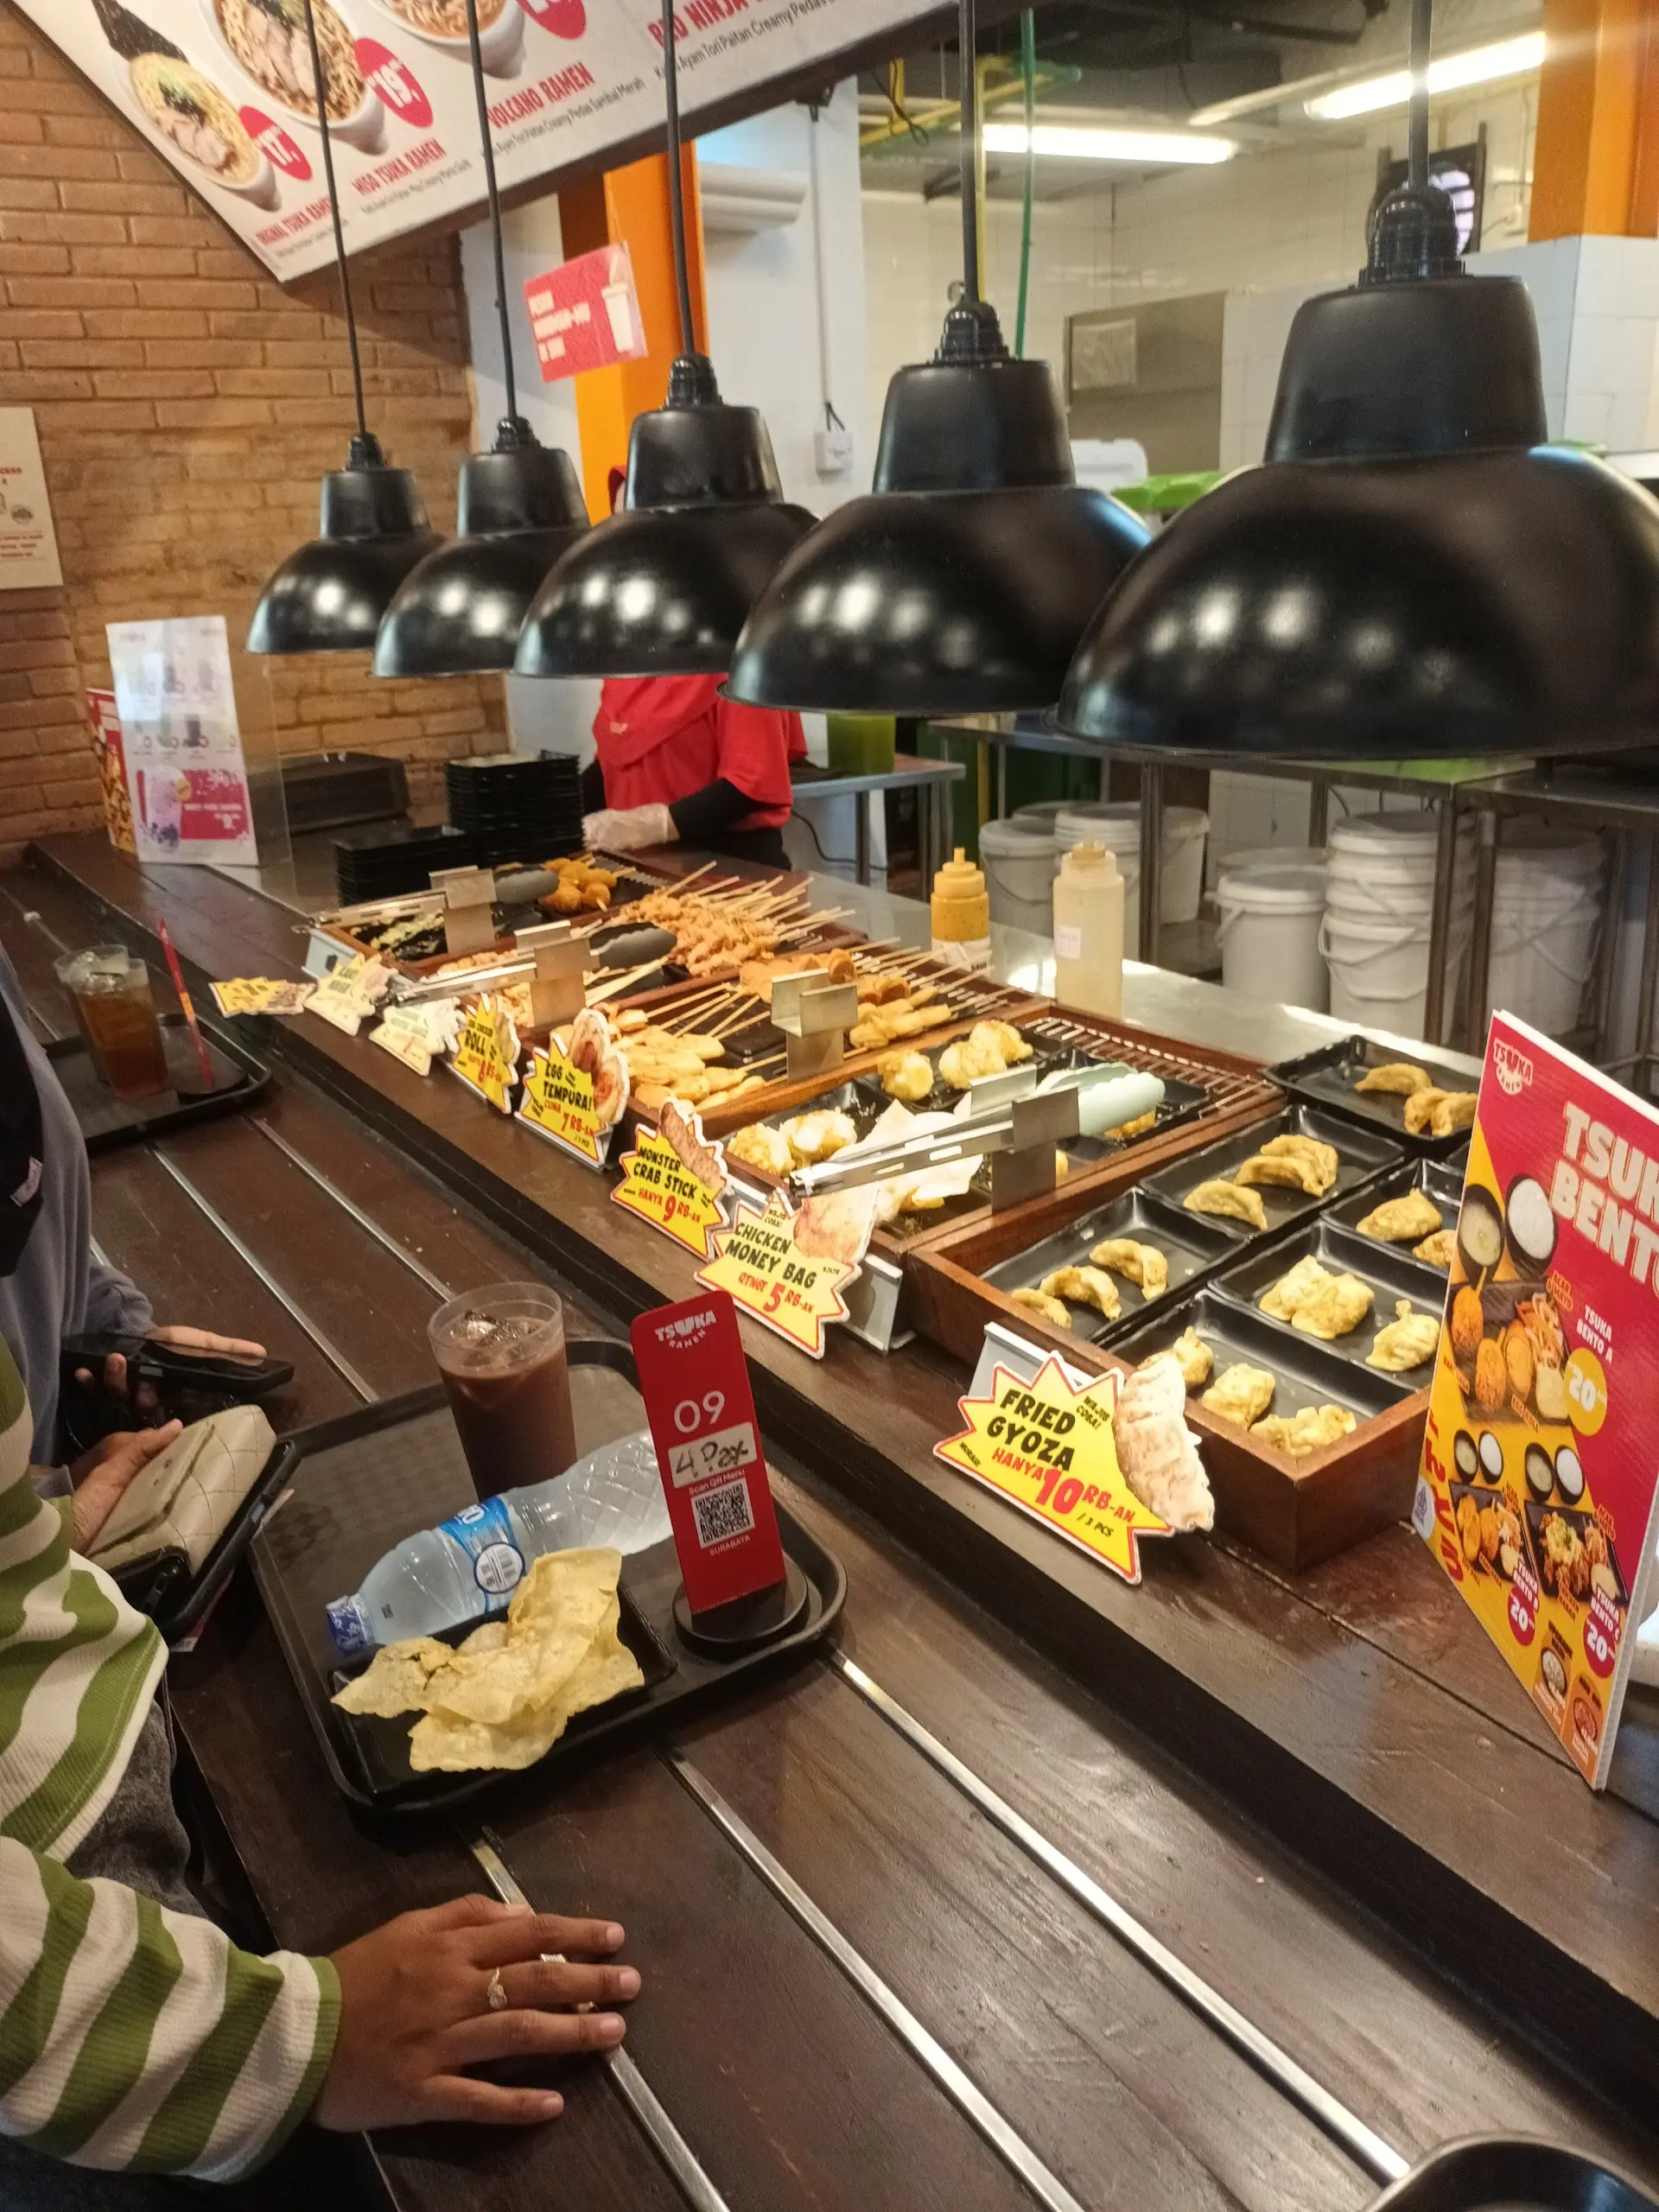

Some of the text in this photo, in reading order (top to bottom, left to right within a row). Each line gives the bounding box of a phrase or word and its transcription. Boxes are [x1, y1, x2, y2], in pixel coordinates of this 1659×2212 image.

[486, 60, 596, 130] VOLCANO RAMEN
[465, 1029, 486, 1056] ROLL
[1493, 1037, 1533, 1085] TSUKA
[545, 1061, 563, 1081] EGG
[543, 1080, 592, 1112] TEMPURA!
[560, 1112, 570, 1132] 7
[639, 1146, 681, 1173] MONSTER
[1562, 1100, 1659, 1226] TSUK
[633, 1162, 697, 1199] CRAB STICK
[638, 1186, 663, 1207] HANYA
[663, 1194, 677, 1223] 9
[734, 1222, 791, 1255] CHICKEN
[1549, 1158, 1659, 1300] BENT
[725, 1239, 817, 1289] MONEY BAG
[762, 1281, 786, 1313] 5
[654, 1309, 717, 1342] TSUKA
[668, 1328, 707, 1350] RAMEN
[1576, 1318, 1613, 1365] BENTO A
[1585, 1304, 1612, 1342] TSUKA
[1568, 1364, 1598, 1413] 20
[674, 1389, 726, 1433] 09
[1000, 1389, 1076, 1436] FRIED
[987, 1415, 1076, 1472] GYOZA
[689, 1468, 746, 1495] Scan QR Menu
[992, 1446, 1045, 1482] HANYA
[1035, 1468, 1085, 1516] 10
[709, 1534, 751, 1557] SURABAYA
[1092, 1522, 1115, 1538] PCS
[1518, 1560, 1538, 1595] TSUKA
[1510, 1598, 1529, 1632] 20
[1596, 1585, 1620, 1622] TSUKA
[1586, 1623, 1608, 1662] 20
